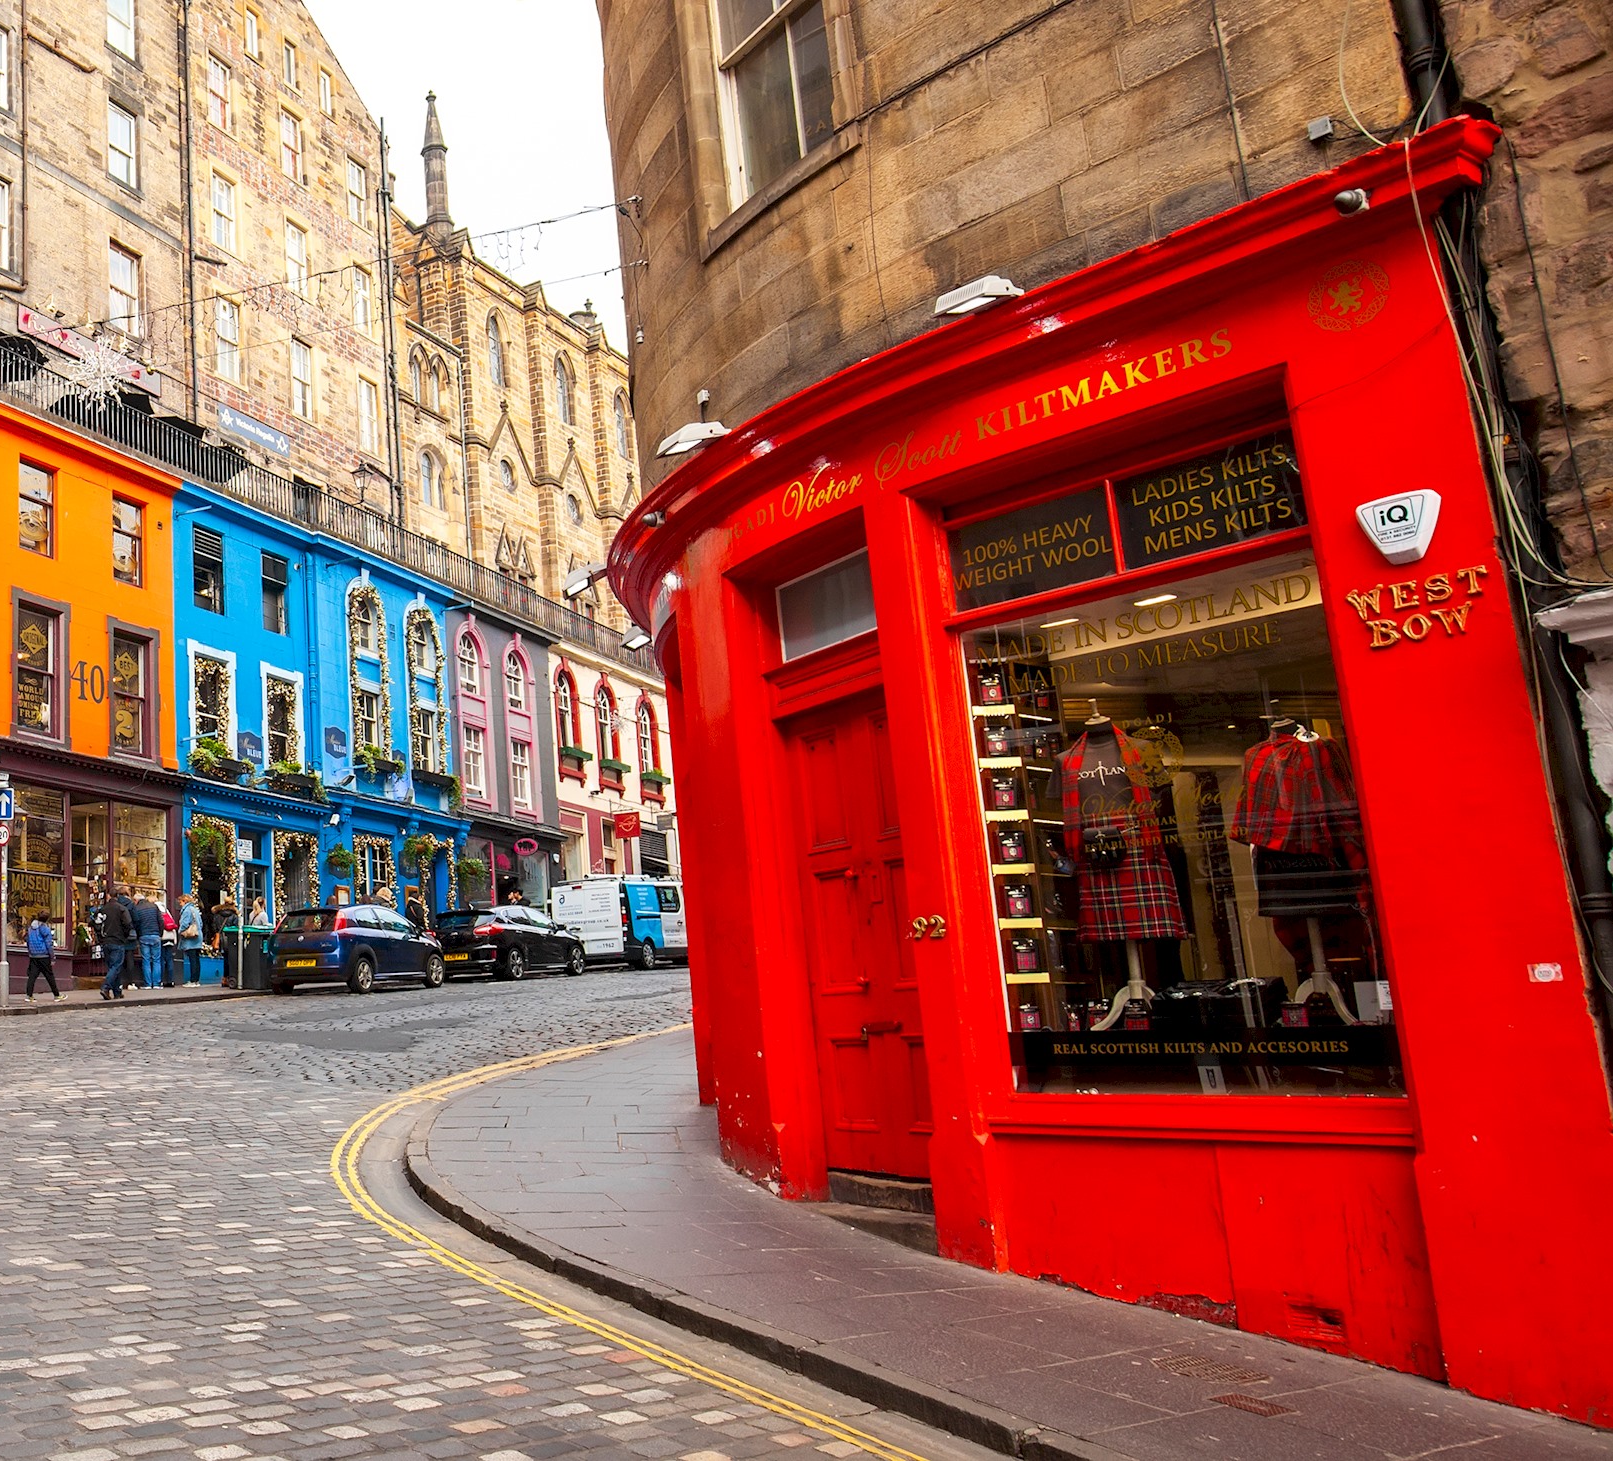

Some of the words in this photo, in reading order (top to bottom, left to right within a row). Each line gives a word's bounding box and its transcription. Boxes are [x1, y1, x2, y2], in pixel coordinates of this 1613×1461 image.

[781, 462, 864, 521] Victor
[873, 429, 962, 490] Scott
[974, 327, 1234, 441] KILTMAKERS
[1131, 466, 1215, 507] LADIES
[1148, 495, 1204, 528] KIDS
[1211, 475, 1277, 511] KILTS
[1143, 518, 1218, 555] MENS
[1224, 497, 1293, 534] KILTS
[1379, 504, 1409, 526] iQ
[952, 553, 1036, 592] WEIGHT
[1040, 534, 1113, 569] WOOL
[962, 534, 1018, 568] 100%
[1022, 514, 1093, 551] HEAVY
[1345, 564, 1489, 621] WEST
[976, 632, 1068, 670] MADE
[1073, 617, 1108, 649] IN
[1116, 574, 1313, 640] SCOTLAND
[1366, 600, 1473, 648] BOW
[1008, 662, 1086, 693] MADE
[1090, 653, 1129, 679] TO
[1138, 619, 1282, 668] MEASURE
[18, 683, 45, 695] WORLD
[70, 659, 105, 704] 40
[115, 709, 135, 738] 2
[1164, 834, 1178, 844] IN
[11, 873, 58, 896] MUSEUM
[912, 914, 947, 941] 92
[1053, 1043, 1088, 1055] REAL
[1090, 1042, 1160, 1055] SCOTTISH
[1163, 1041, 1206, 1055] KILTS
[1210, 1041, 1243, 1054] AND
[1247, 1040, 1350, 1054] ACCESORIES
